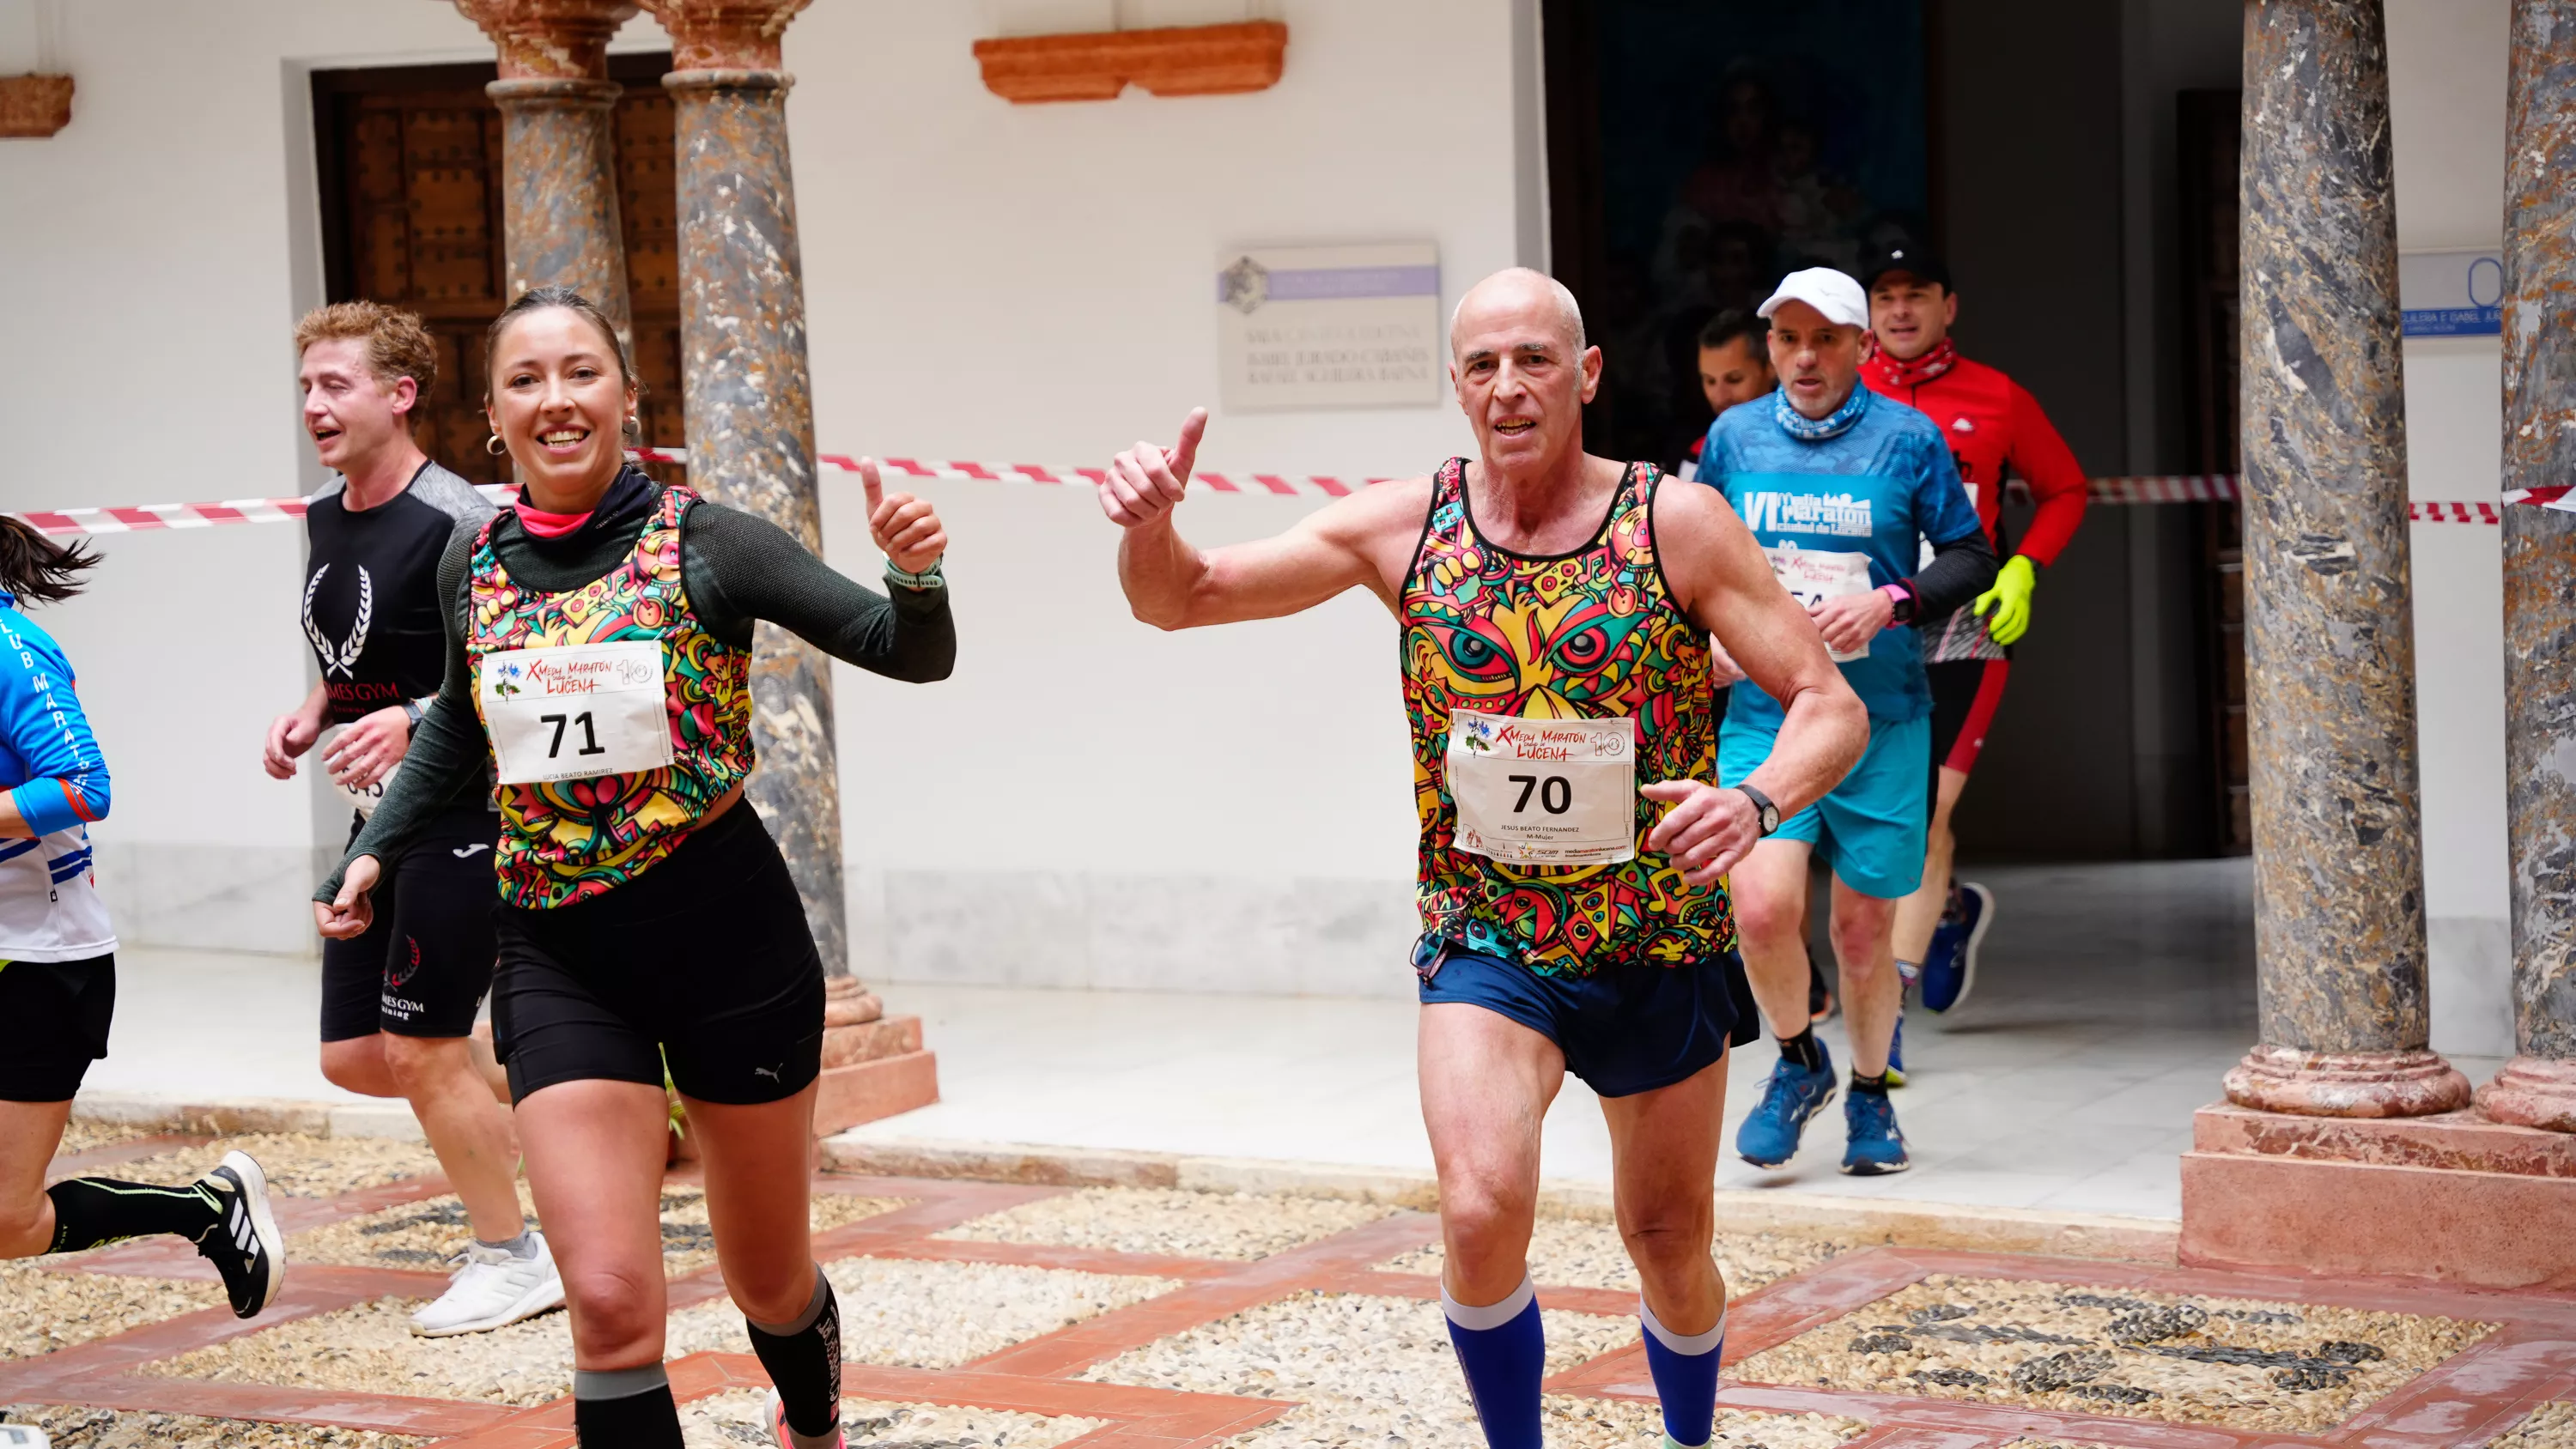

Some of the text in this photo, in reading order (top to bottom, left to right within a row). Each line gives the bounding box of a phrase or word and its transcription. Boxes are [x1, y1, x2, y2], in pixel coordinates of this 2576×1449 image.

[1745, 491, 1778, 532] VI
[0, 616, 34, 669] LUB
[355, 682, 400, 700] GYM
[547, 678, 602, 694] LUCENA
[540, 711, 605, 759] 71
[1541, 731, 1587, 743] MARATÓN
[1516, 743, 1575, 761] LUCENA
[1508, 774, 1572, 815] 70
[398, 998, 425, 1013] GYM
